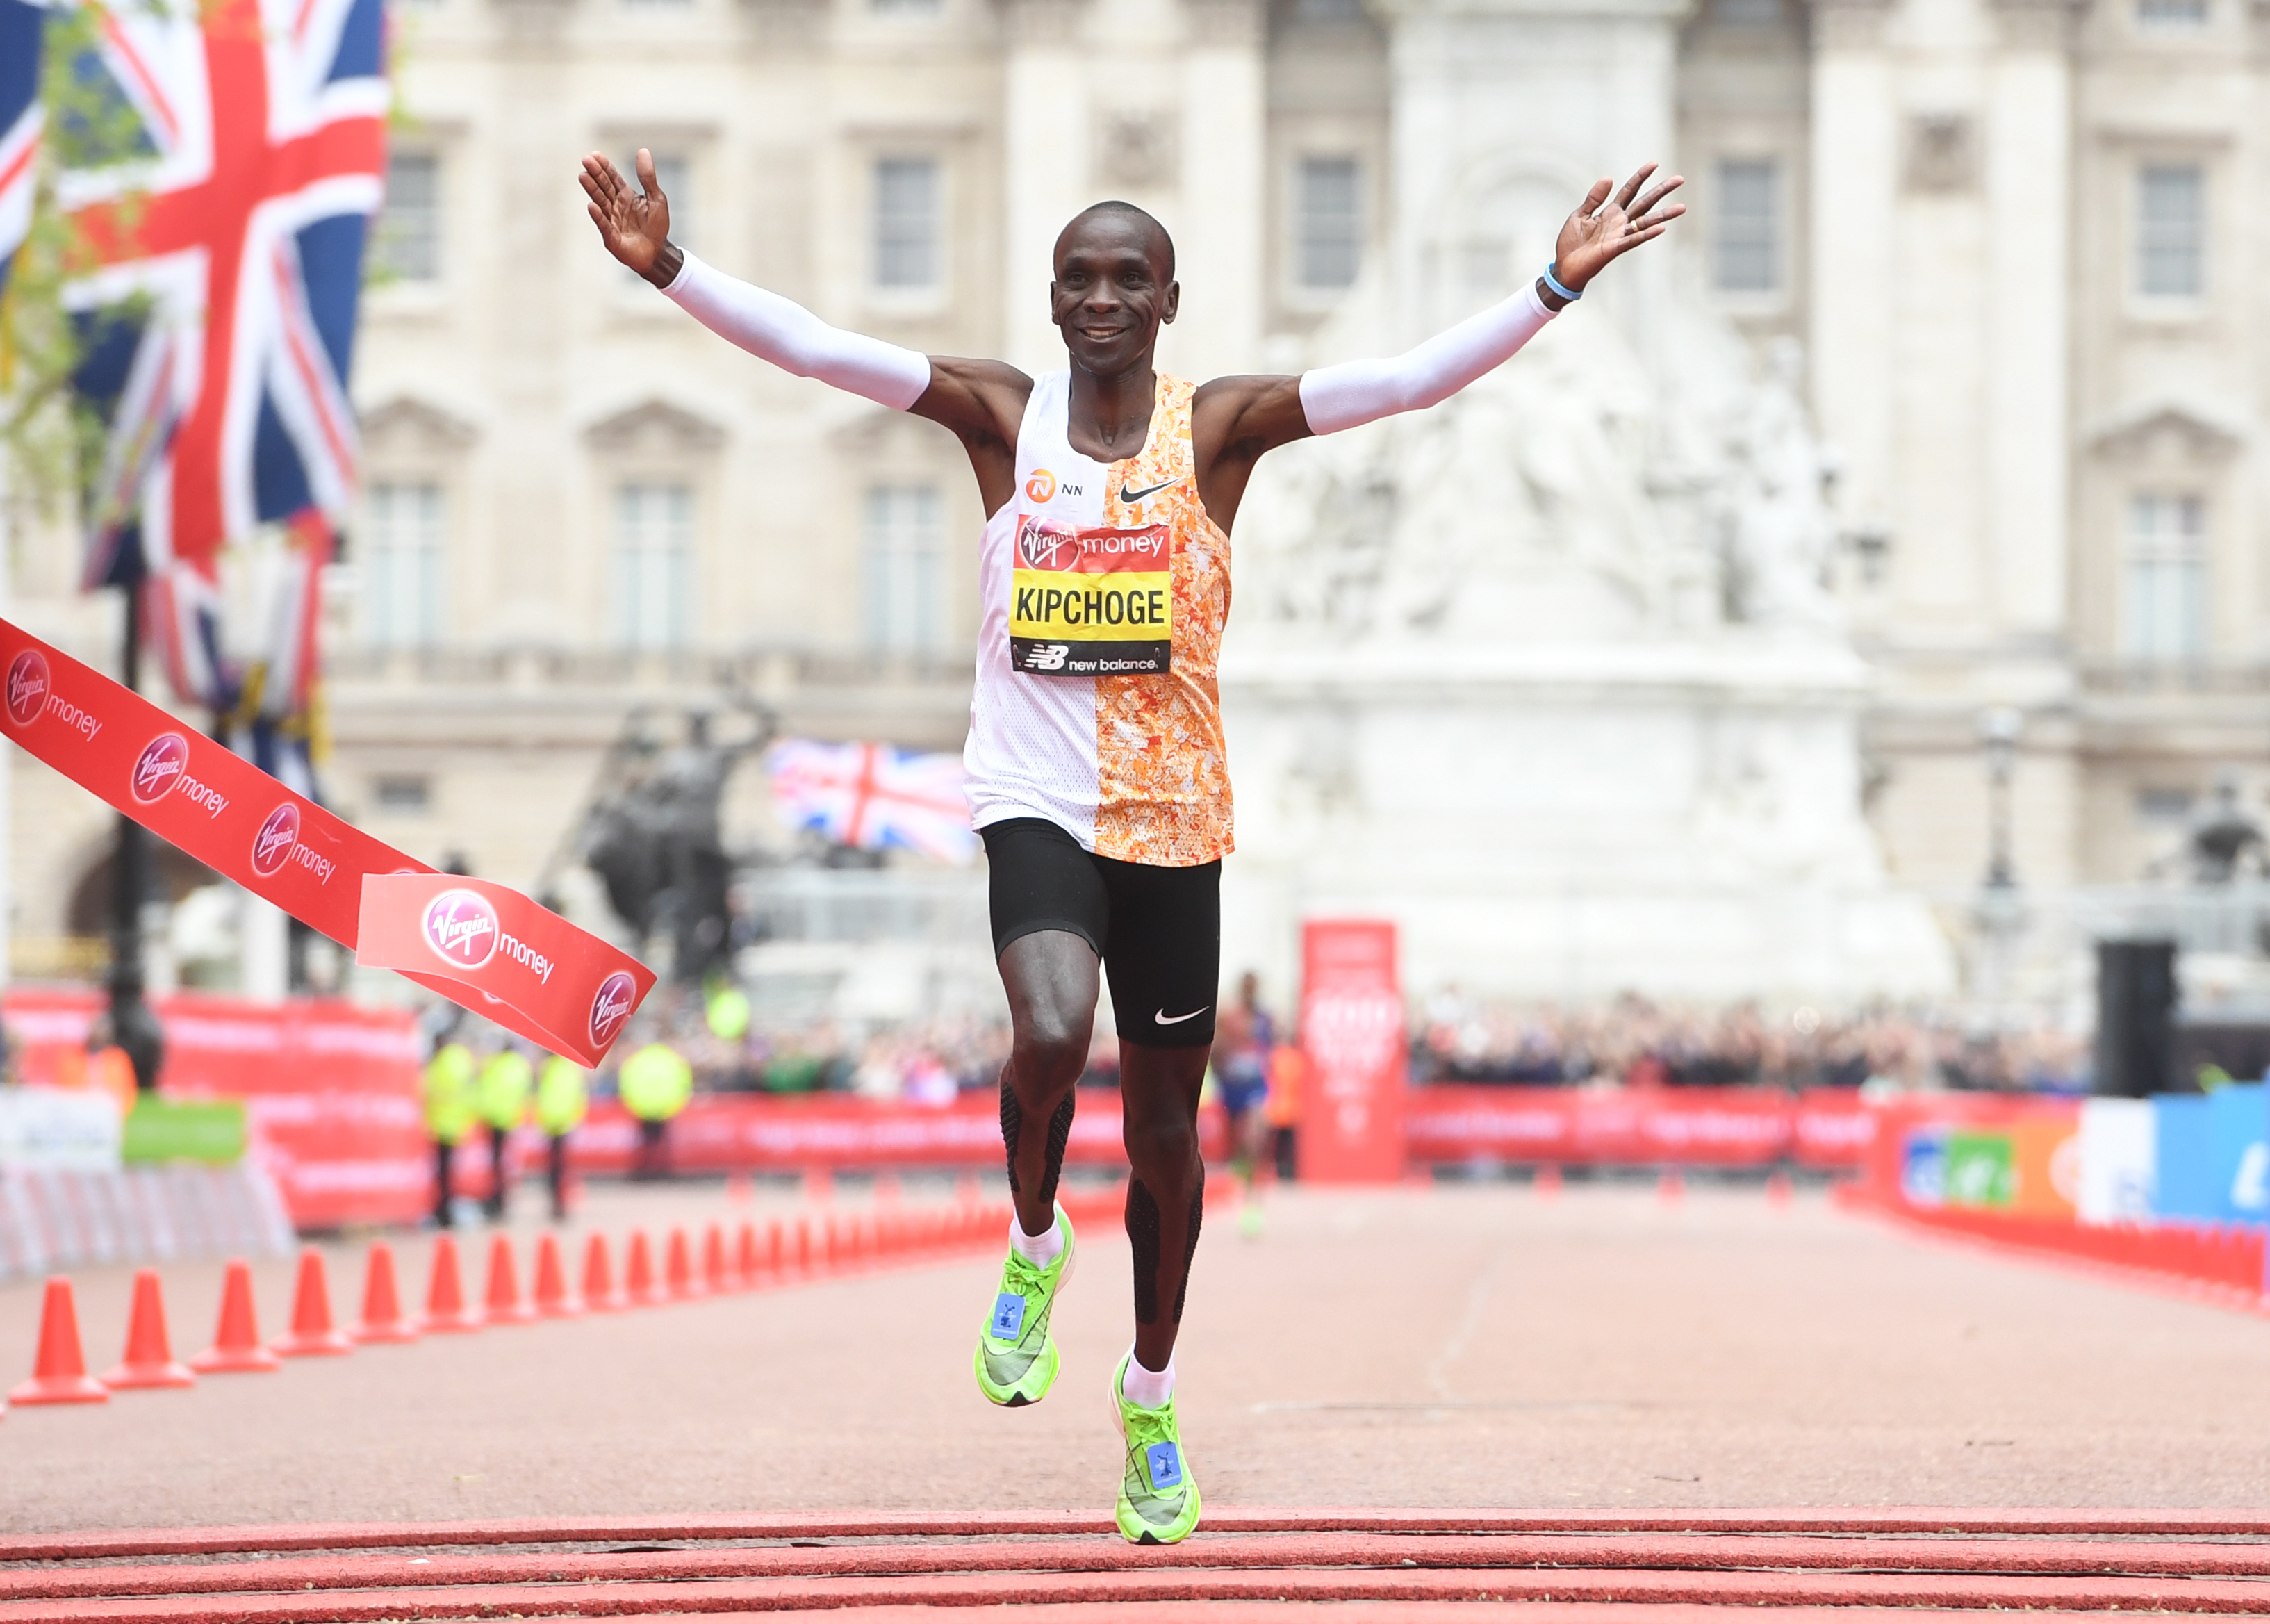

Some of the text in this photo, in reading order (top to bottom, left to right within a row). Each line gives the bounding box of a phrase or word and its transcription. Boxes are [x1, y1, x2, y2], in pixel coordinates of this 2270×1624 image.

[1062, 484, 1083, 496] NN
[1024, 517, 1165, 567] Virgin money
[1016, 587, 1165, 624] KIPCHOGE
[1069, 659, 1098, 671] new
[10, 659, 103, 742] Virgin money
[138, 741, 230, 819] Virgin money
[258, 812, 336, 885] Virgin money
[432, 900, 554, 985] Virgin money
